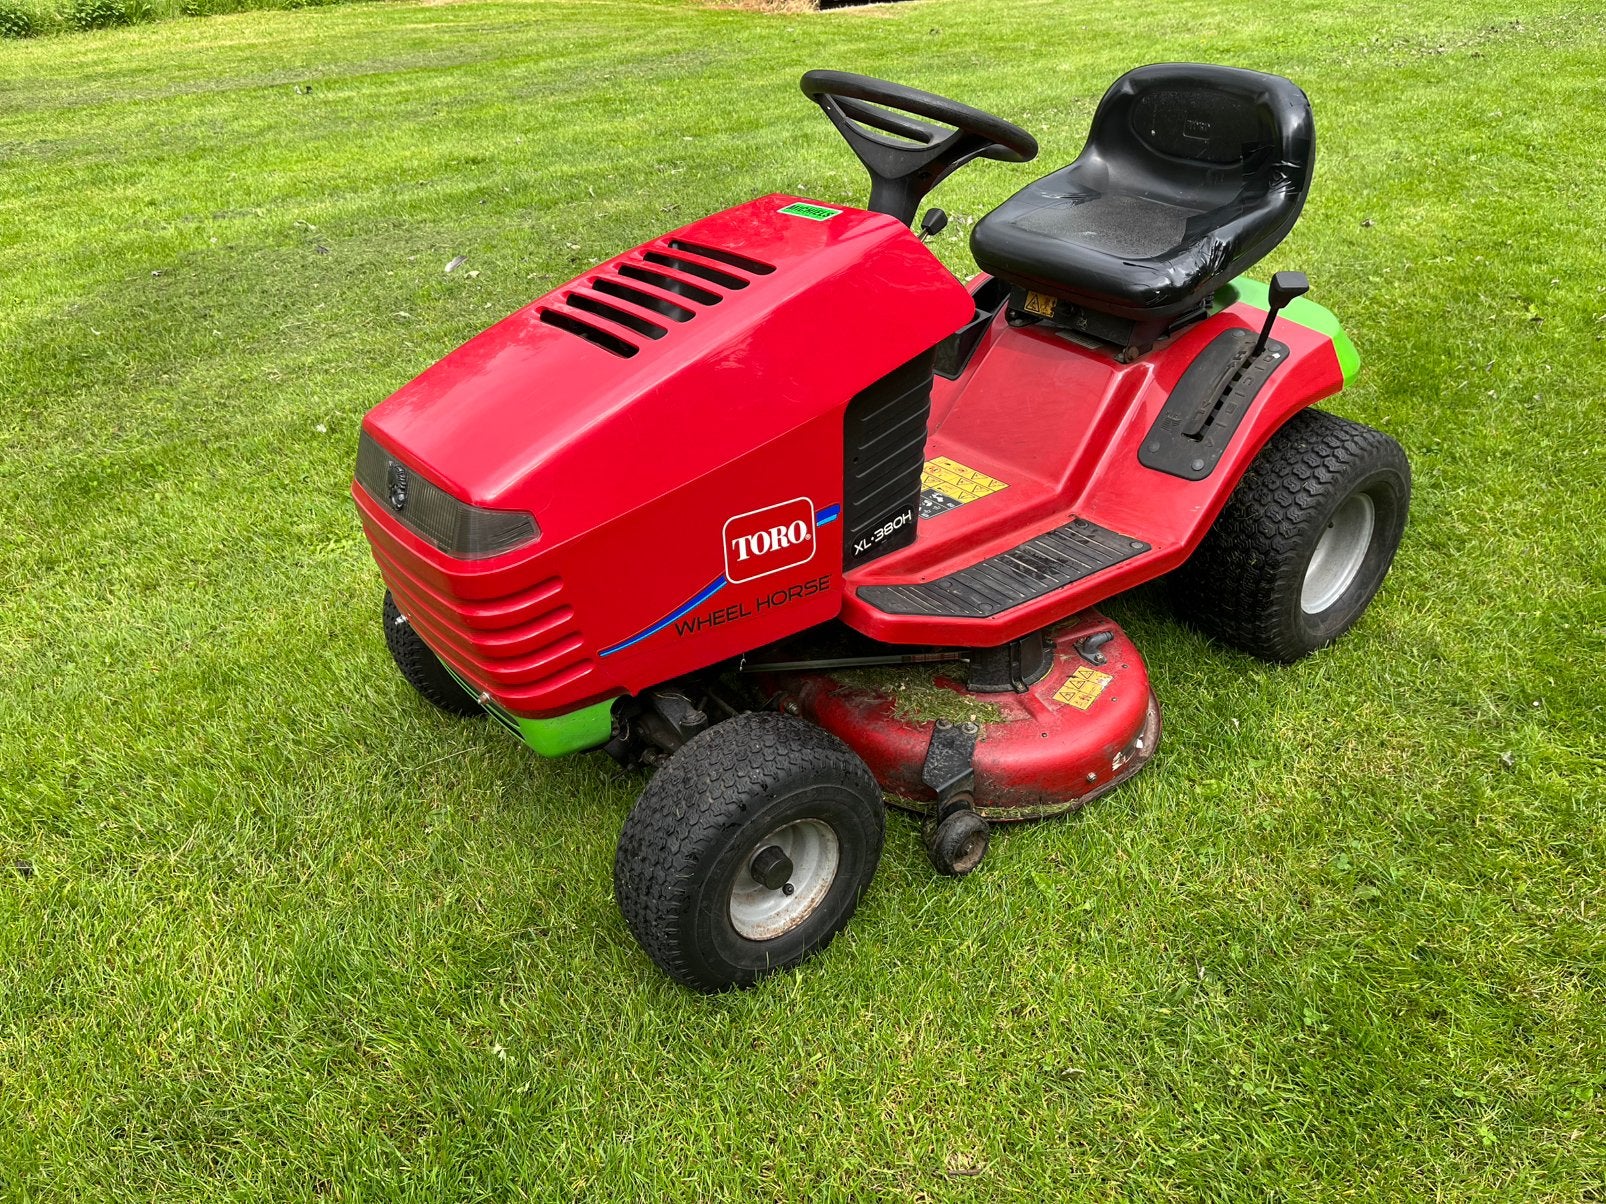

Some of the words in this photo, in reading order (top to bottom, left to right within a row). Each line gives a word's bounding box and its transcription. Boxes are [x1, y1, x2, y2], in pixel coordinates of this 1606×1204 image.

[732, 520, 808, 562] TORO
[674, 603, 751, 637] WHEEL
[756, 574, 830, 613] HORSE
